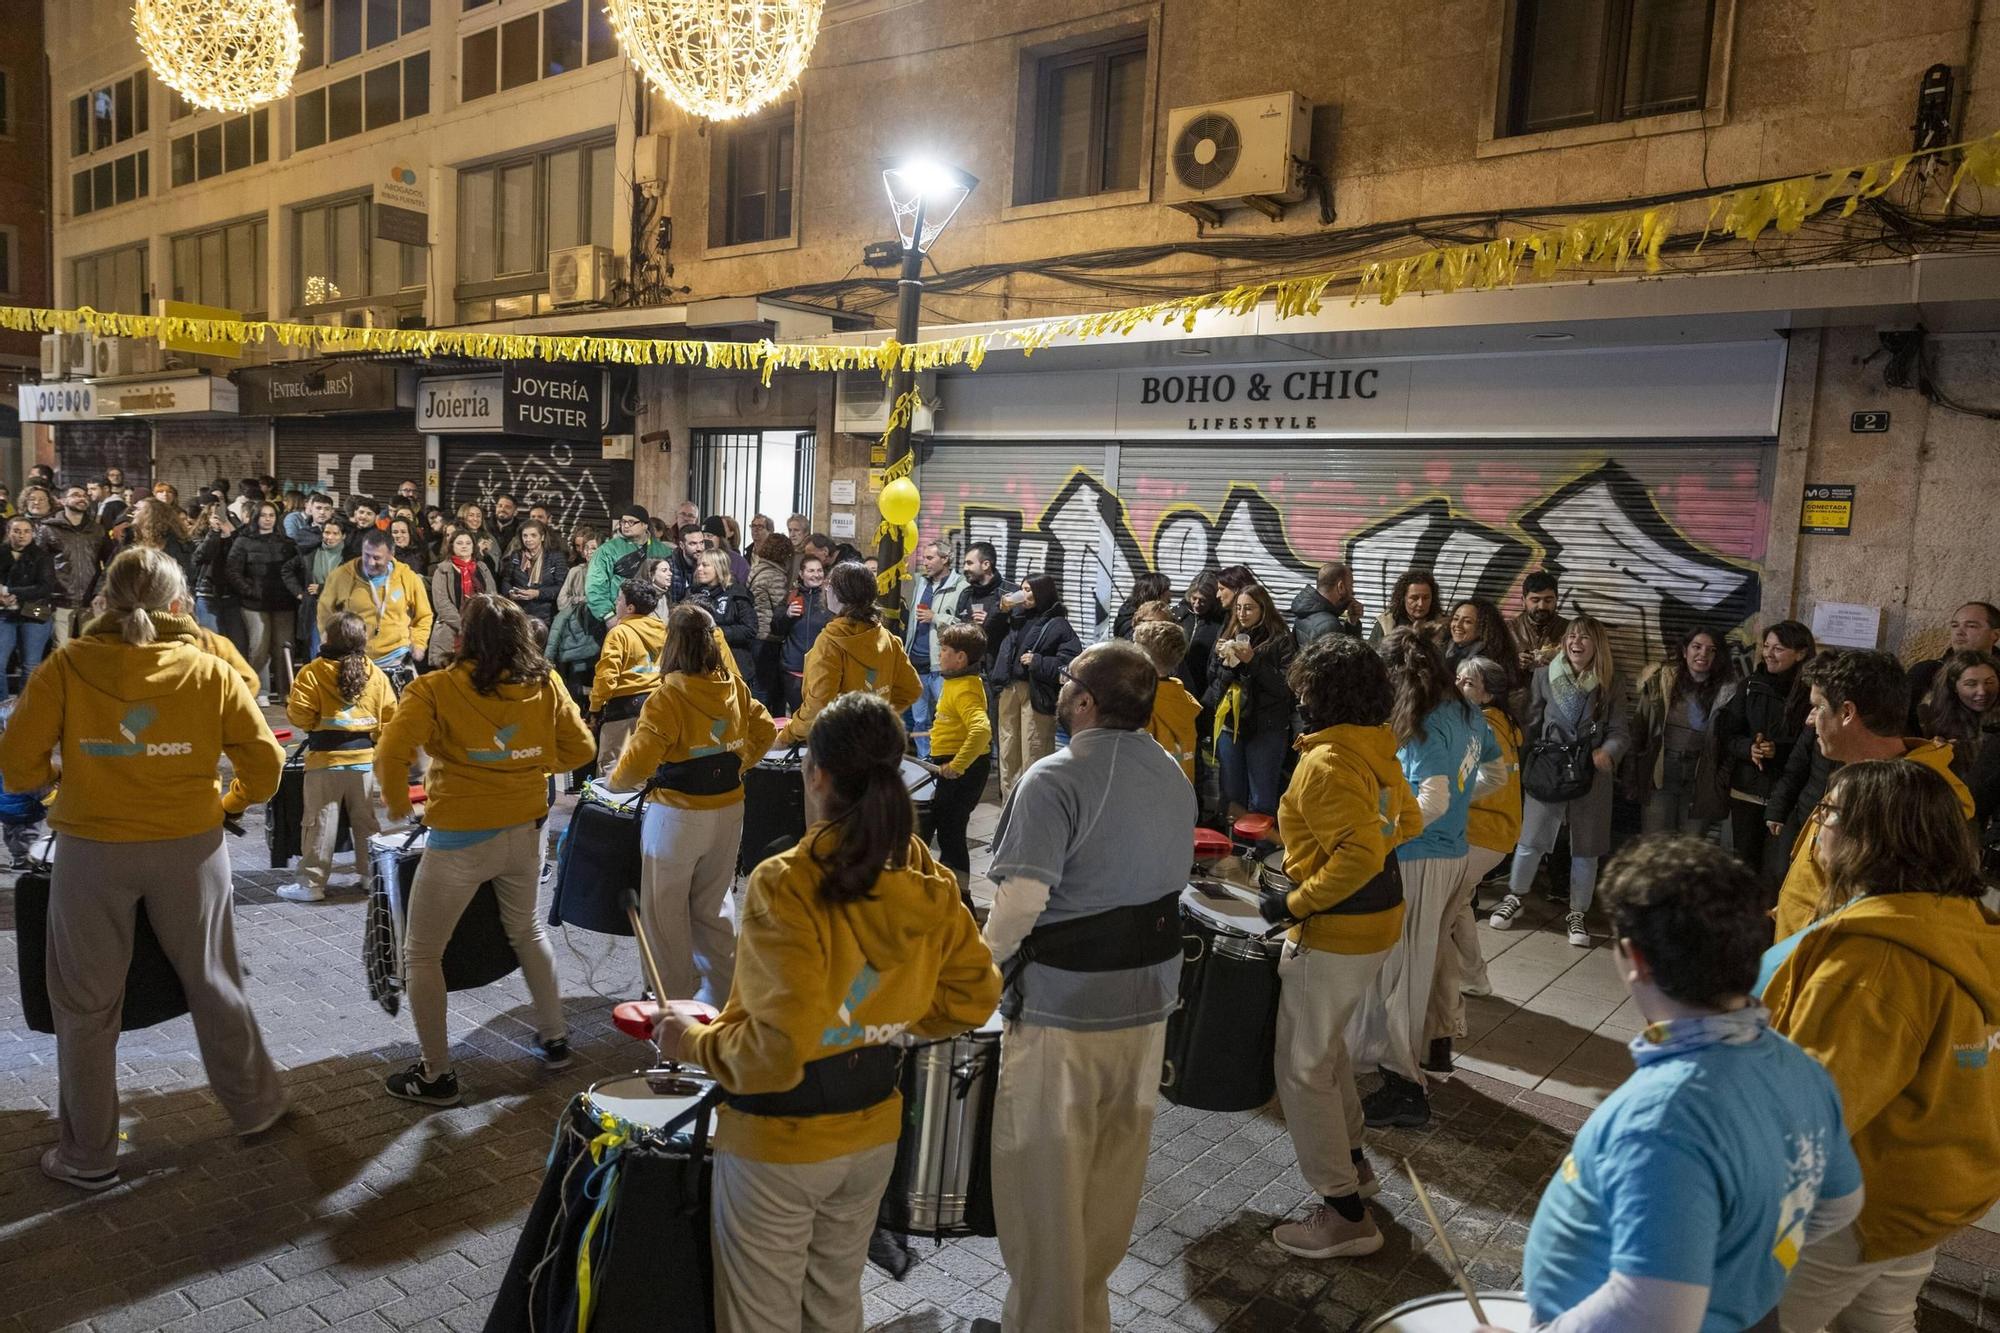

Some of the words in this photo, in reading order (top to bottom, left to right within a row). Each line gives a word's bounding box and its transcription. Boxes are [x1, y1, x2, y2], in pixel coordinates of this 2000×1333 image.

[512, 377, 589, 402] JOYERÍA
[1141, 374, 1236, 404] BOHO
[1247, 373, 1272, 401] &
[1283, 369, 1379, 400] CHIC
[425, 389, 490, 418] Joieria
[519, 404, 588, 428] FUSTER
[1188, 416, 1317, 430] LIFESTYLE
[1864, 414, 1877, 429] 2
